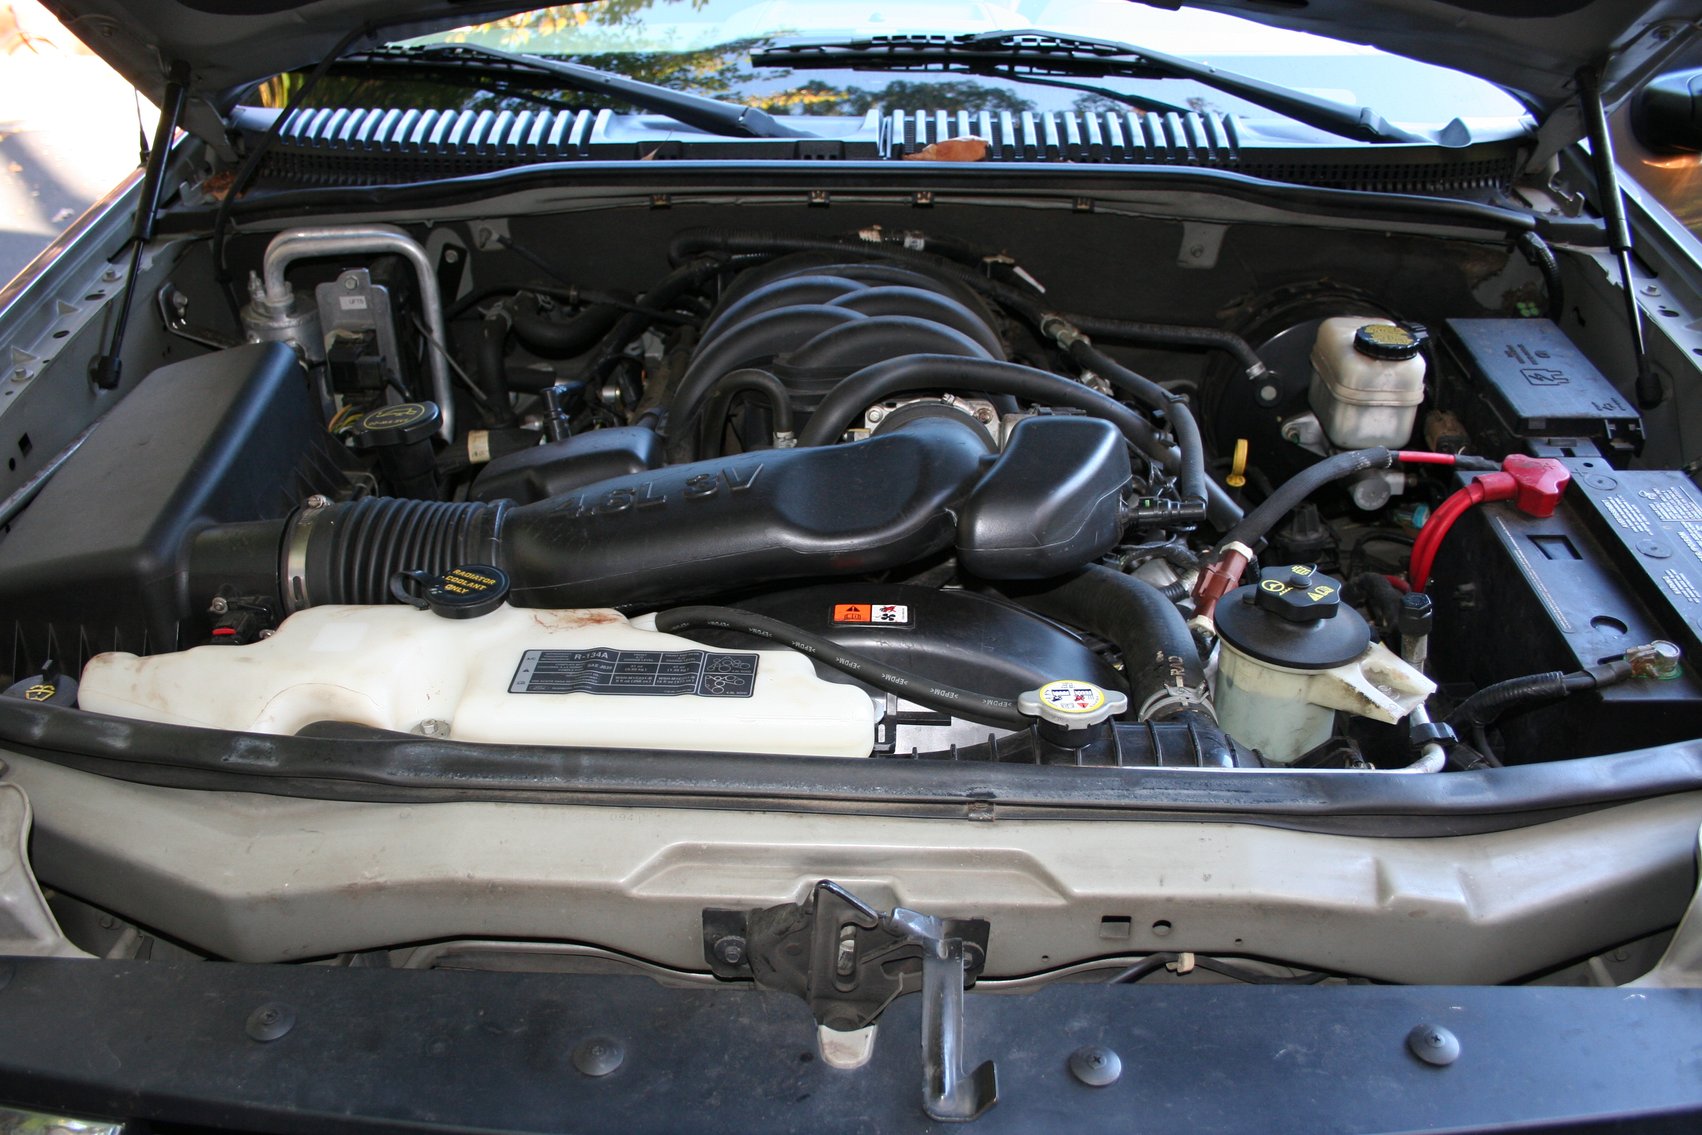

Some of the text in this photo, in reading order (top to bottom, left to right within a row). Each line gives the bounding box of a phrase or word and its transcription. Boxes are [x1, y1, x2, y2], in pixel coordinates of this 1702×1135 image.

[444, 574, 488, 591] COOLANT
[452, 568, 497, 585] RADIATOR
[444, 583, 470, 594] ONLY
[574, 651, 609, 660] R-134A
